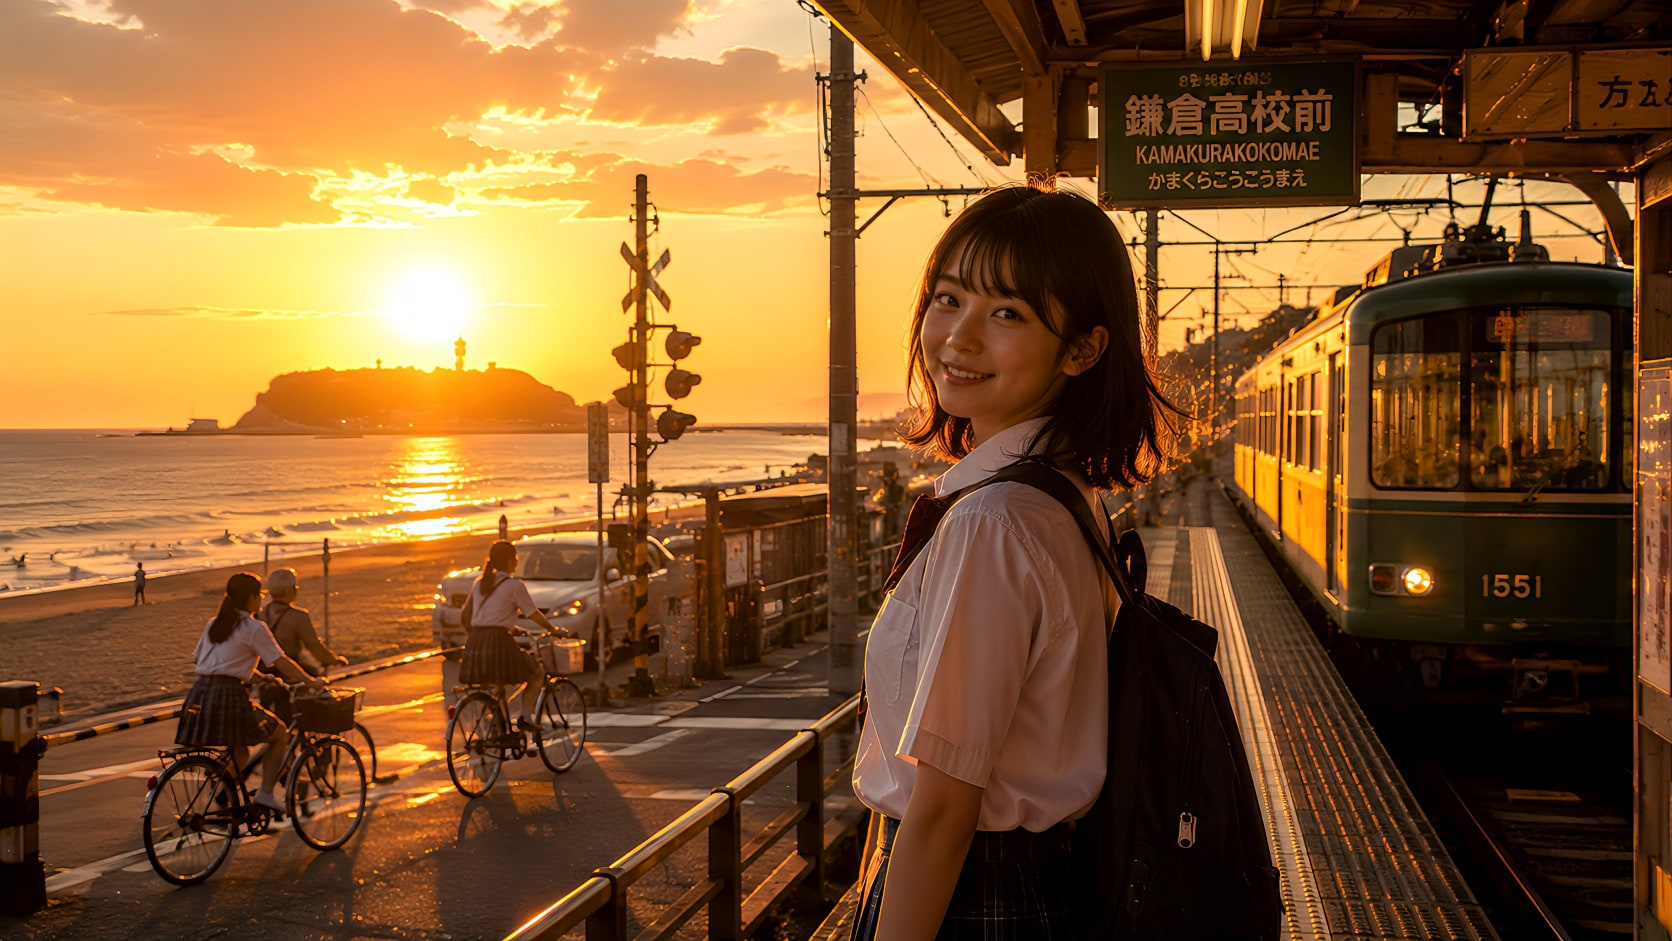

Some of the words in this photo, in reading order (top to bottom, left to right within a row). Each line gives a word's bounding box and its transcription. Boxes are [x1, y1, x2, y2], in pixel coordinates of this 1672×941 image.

[1125, 88, 1333, 137] 鎌倉高校前
[1136, 141, 1320, 165] KAMAKURAKOKOMAE
[1148, 168, 1308, 191] かまくらこうこうまえ
[1481, 574, 1542, 599] 1551
